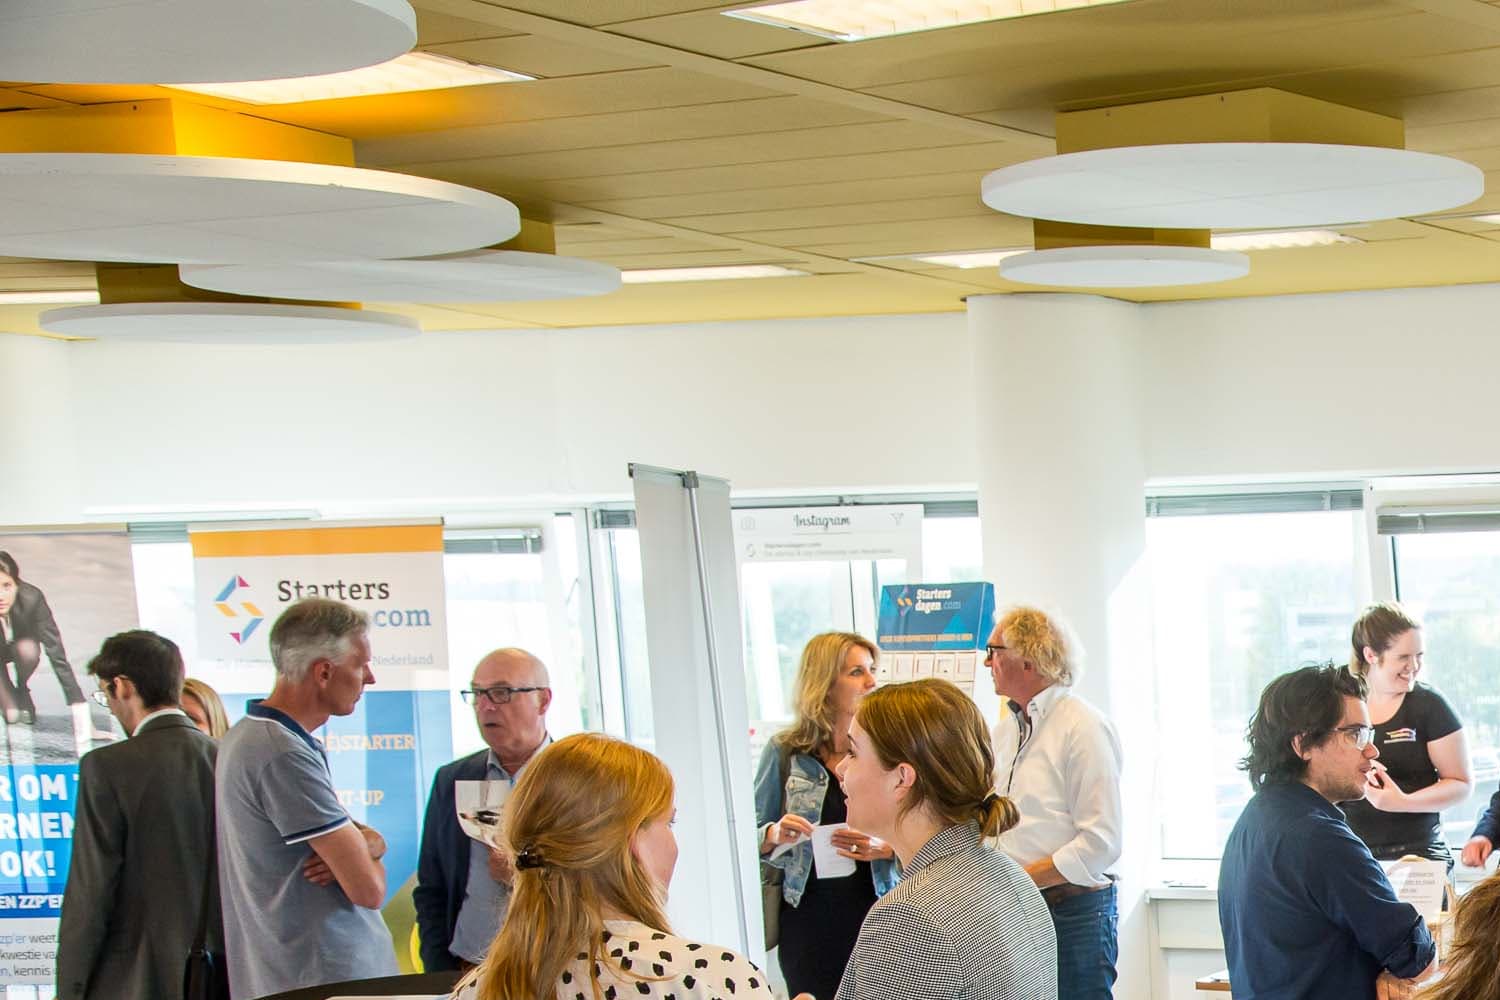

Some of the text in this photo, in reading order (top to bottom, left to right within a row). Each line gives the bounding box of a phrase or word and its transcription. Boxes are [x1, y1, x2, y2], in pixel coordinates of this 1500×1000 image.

[793, 513, 851, 532] Instagram
[277, 580, 390, 602] Starters
[916, 588, 952, 601] Starters
[18, 774, 68, 801] OM
[13, 964, 51, 976] kennis
